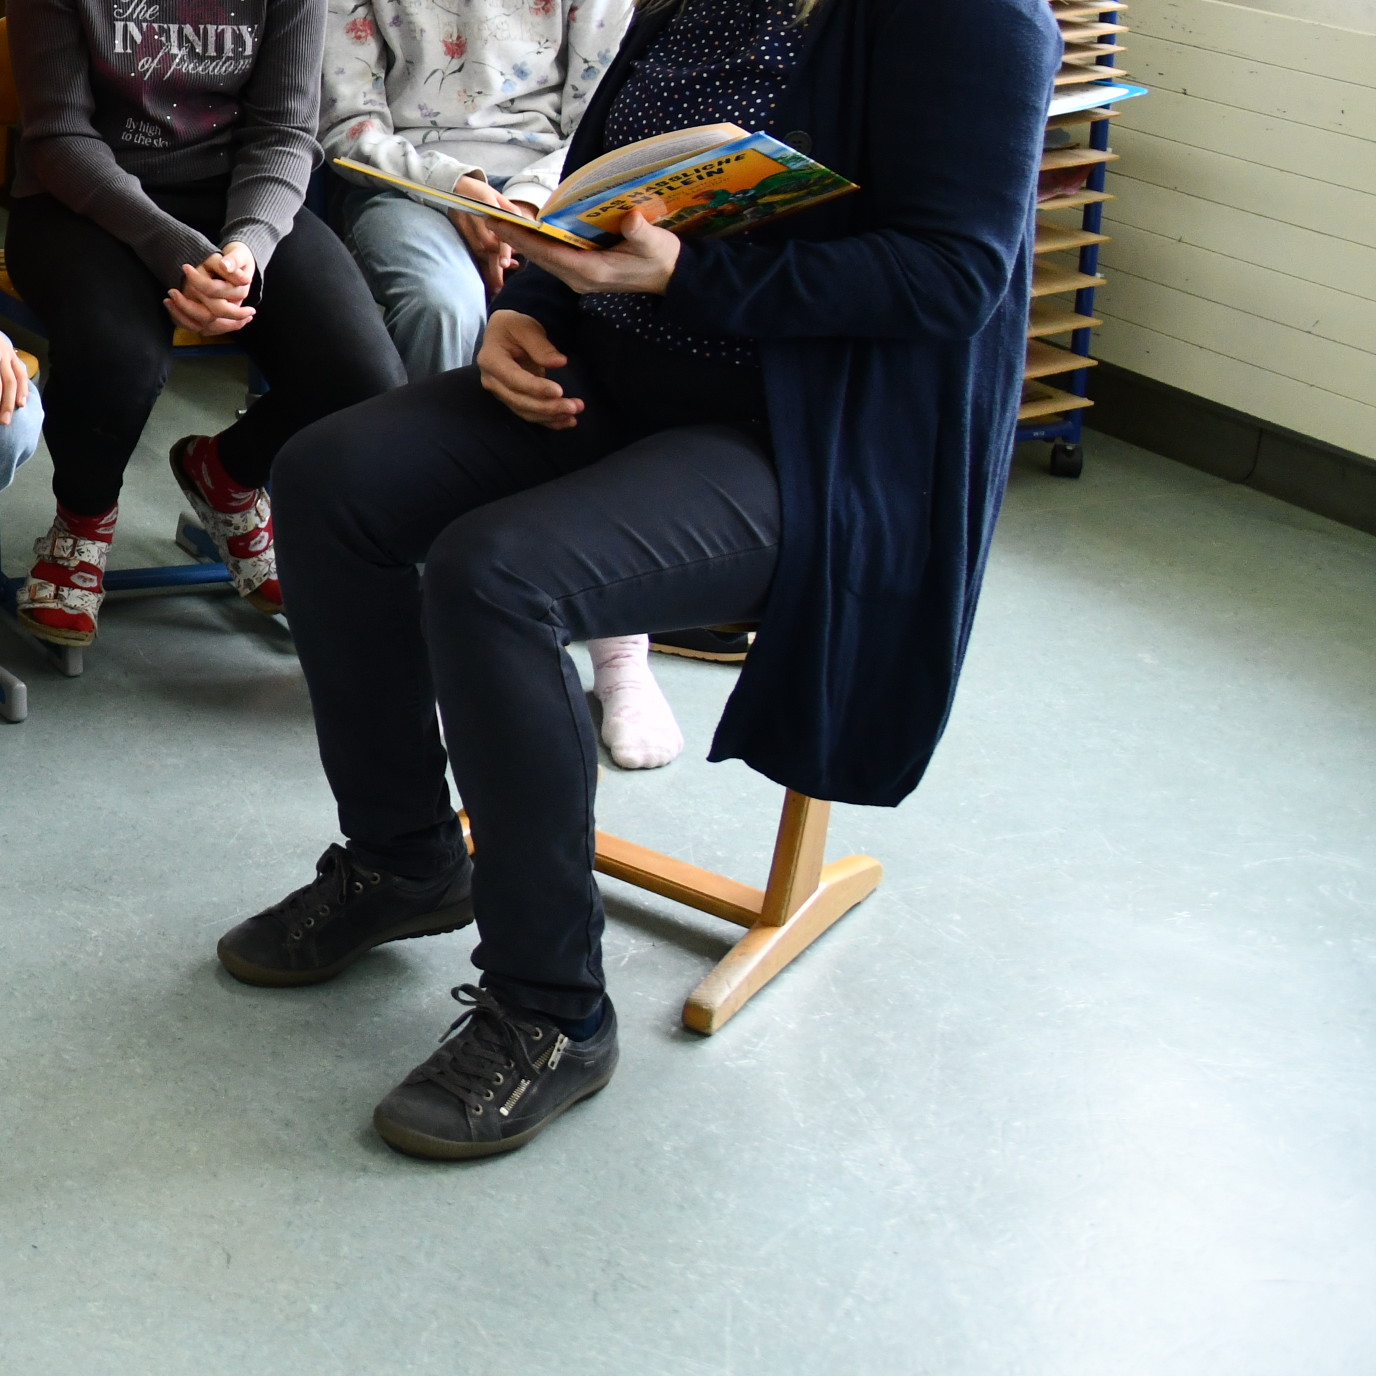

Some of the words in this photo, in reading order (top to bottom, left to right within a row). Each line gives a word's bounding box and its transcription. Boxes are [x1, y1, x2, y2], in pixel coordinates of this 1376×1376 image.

[138, 43, 171, 81] of
[163, 43, 253, 81] freedom
[125, 117, 136, 132] fly
[139, 120, 161, 137] high
[121, 131, 133, 142] to
[134, 132, 152, 146] the
[616, 167, 725, 211] ENTLEIN
[586, 199, 627, 218] DAS
